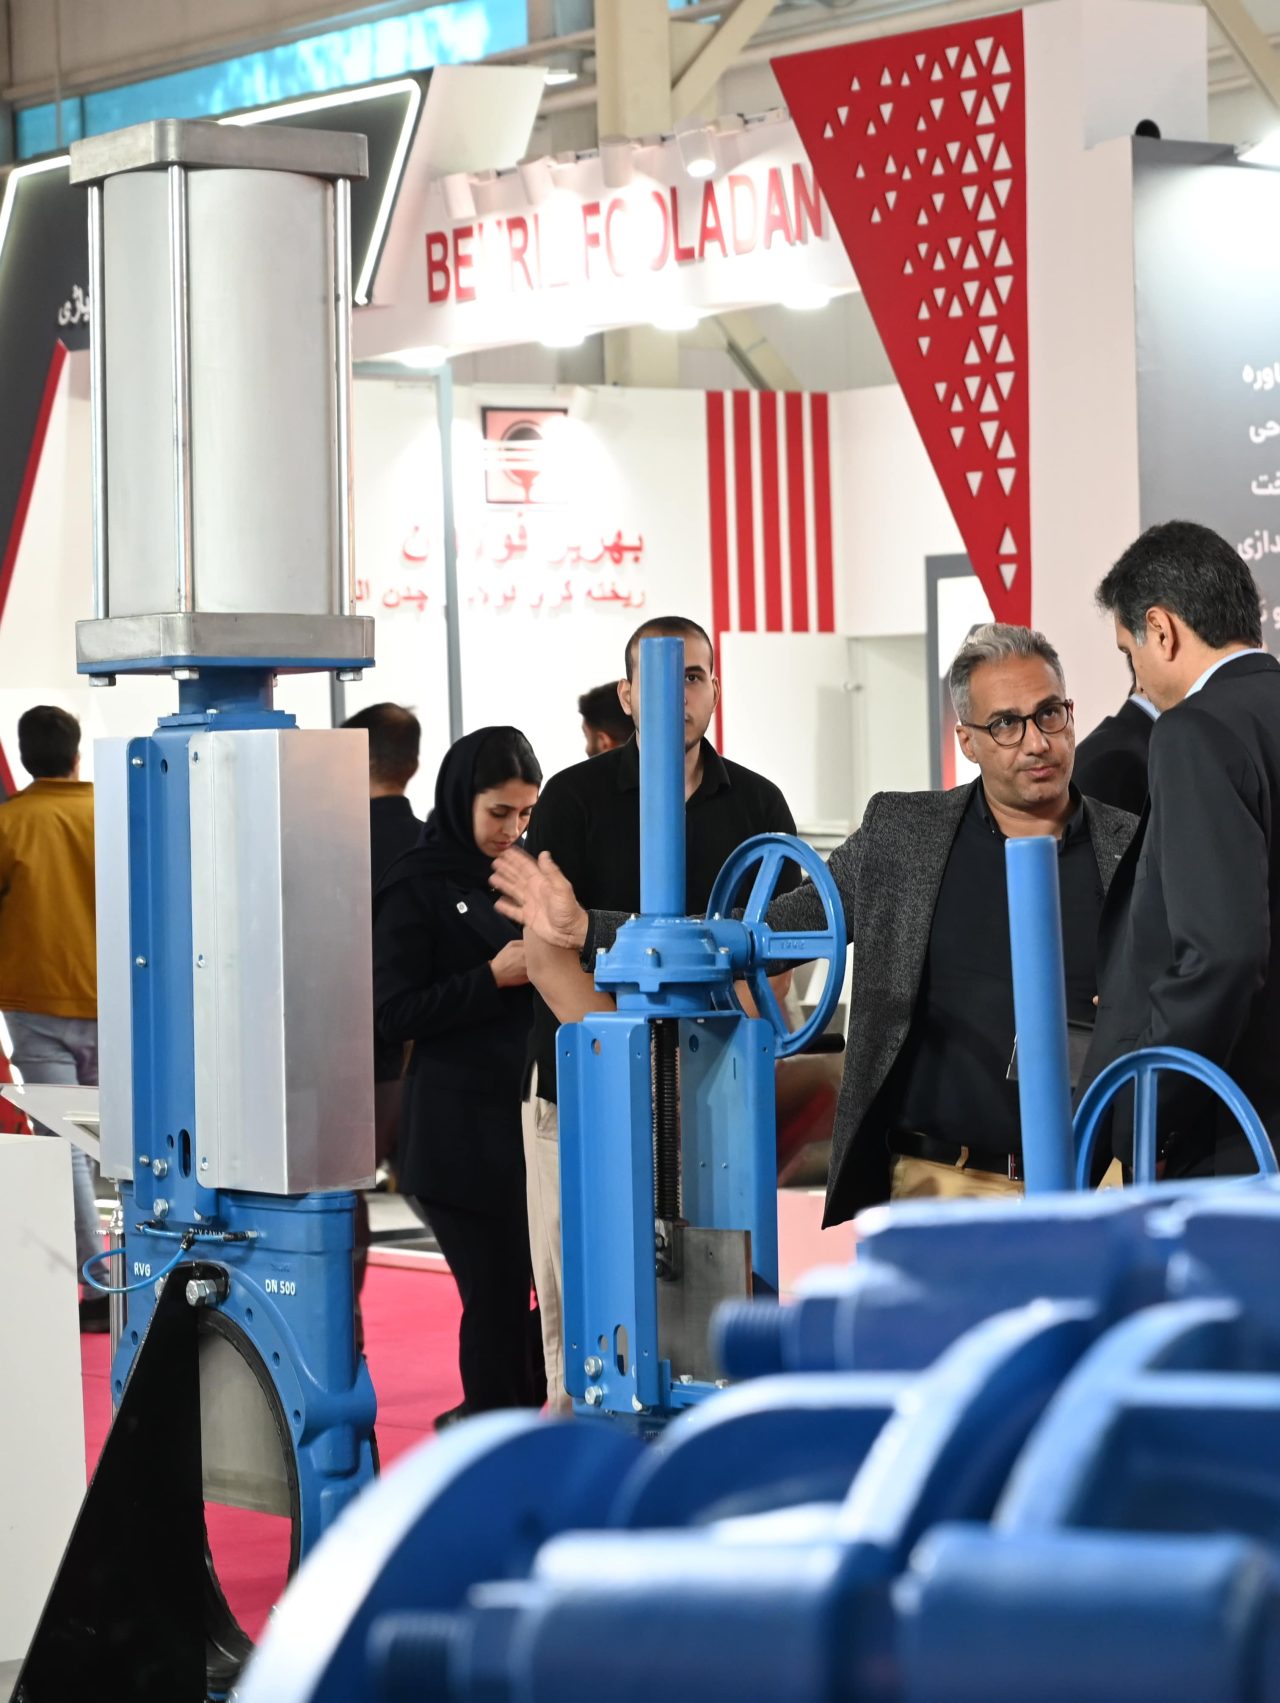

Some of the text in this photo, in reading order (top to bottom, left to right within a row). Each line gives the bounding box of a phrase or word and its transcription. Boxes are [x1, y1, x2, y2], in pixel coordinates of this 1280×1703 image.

[133, 1262, 151, 1276] RVG
[265, 1279, 296, 1296] DN 500
